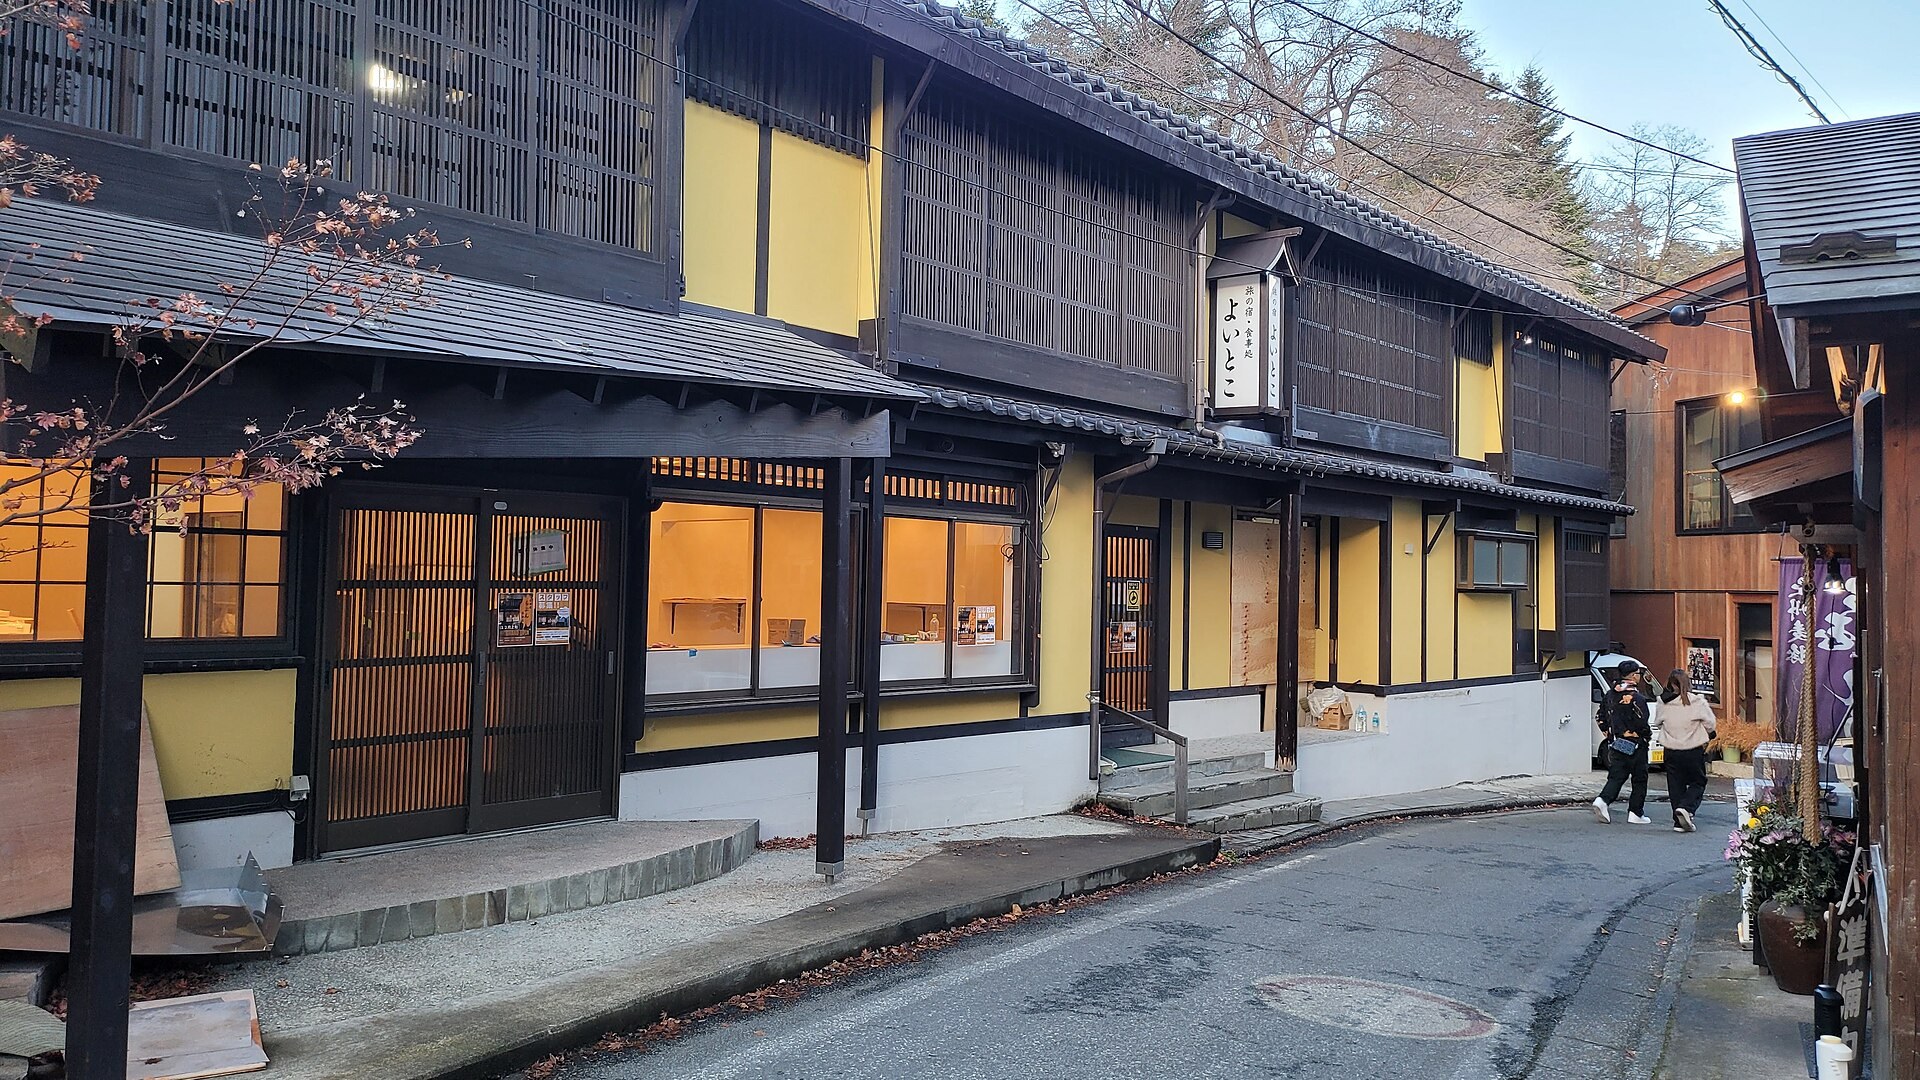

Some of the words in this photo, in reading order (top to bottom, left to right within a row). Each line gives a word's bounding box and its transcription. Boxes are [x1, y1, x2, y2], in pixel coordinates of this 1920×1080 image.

[1222, 298, 1240, 398] よいとこ
[1244, 286, 1255, 359] 旅の宿・食事処
[1270, 323, 1278, 398] よいとこ
[538, 593, 569, 602] スタッフ
